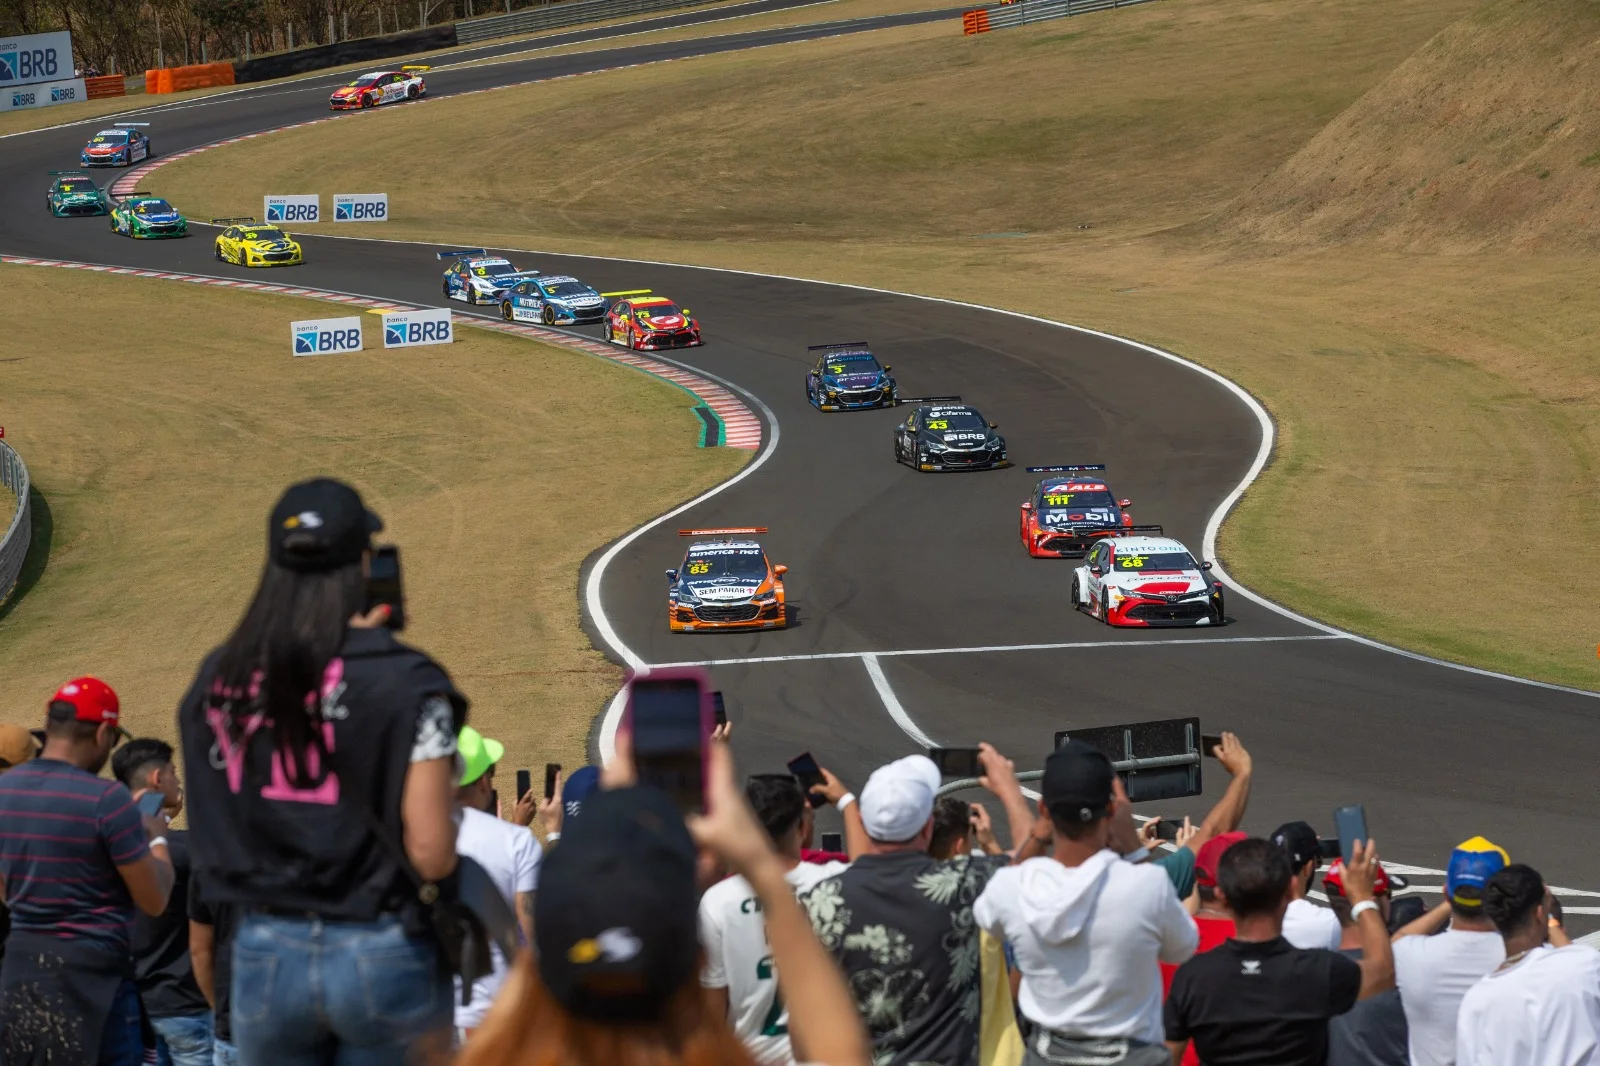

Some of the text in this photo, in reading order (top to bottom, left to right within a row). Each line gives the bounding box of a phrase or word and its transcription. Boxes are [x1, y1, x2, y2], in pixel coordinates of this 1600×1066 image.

[19, 48, 57, 78] BRB
[20, 93, 35, 105] BRB
[59, 88, 75, 100] BRB
[285, 204, 318, 221] BRB
[353, 202, 386, 219] BRB
[408, 320, 450, 343] BRB
[318, 328, 360, 351] BRB
[928, 422, 948, 430] 43
[1048, 498, 1069, 506] 111
[1045, 512, 1116, 524] Mobil
[1122, 559, 1145, 568] 68
[690, 566, 709, 575] 85
[699, 586, 745, 596] SEM PARAR
